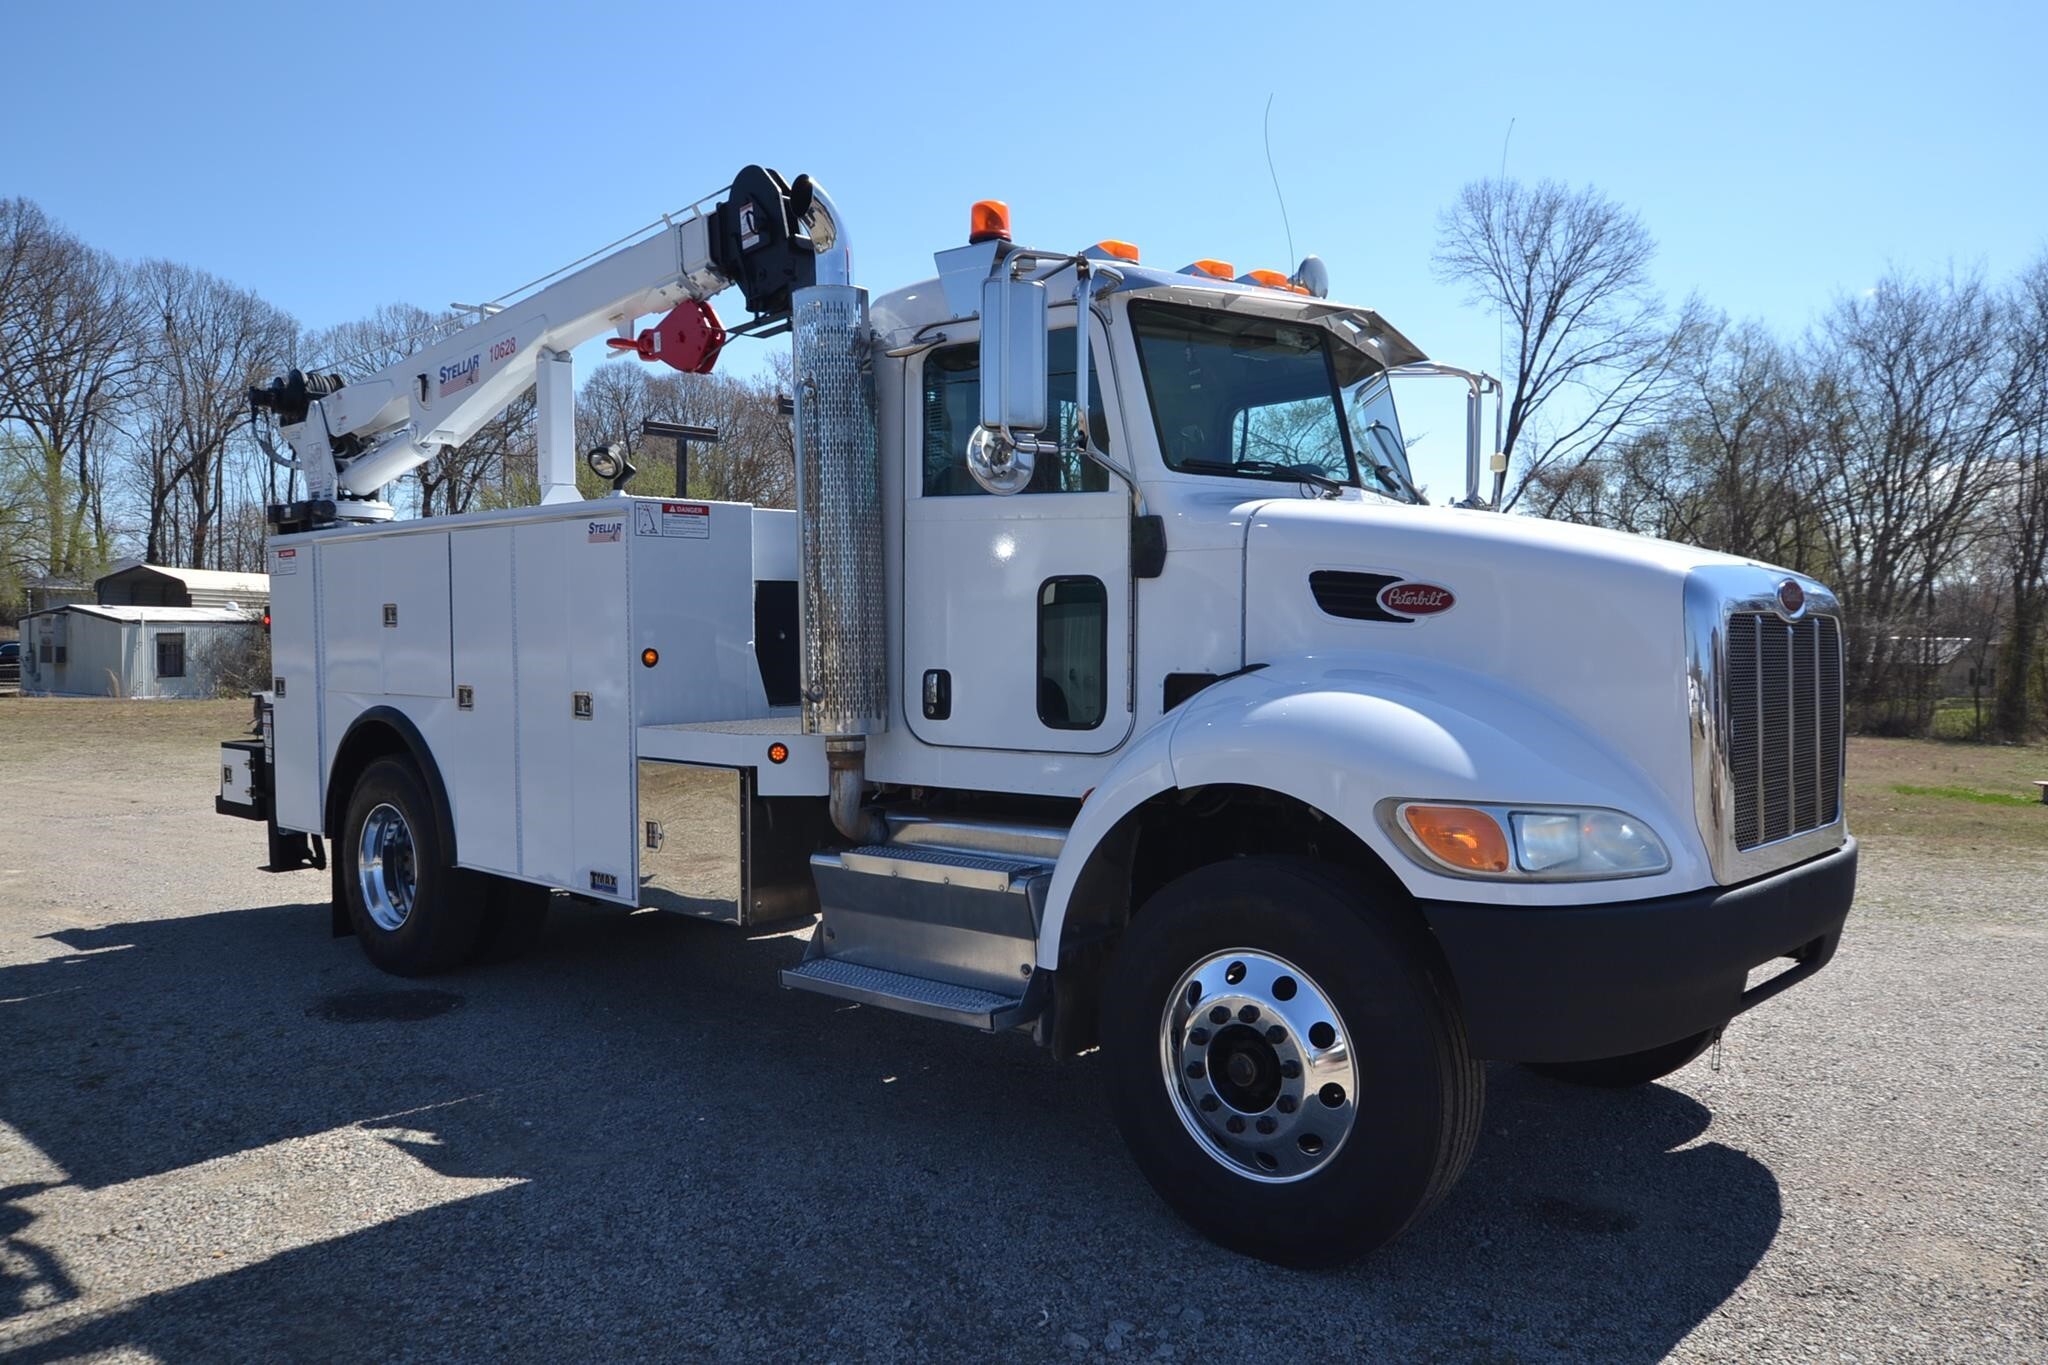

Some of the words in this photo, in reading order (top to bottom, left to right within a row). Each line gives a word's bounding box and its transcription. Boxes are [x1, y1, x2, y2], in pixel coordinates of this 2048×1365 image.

[489, 337, 516, 362] 10628
[439, 354, 480, 384] STELLAR
[676, 505, 704, 514] DANGER
[588, 522, 622, 534] STELLAR
[1388, 588, 1449, 606] Peterbilt
[590, 871, 617, 888] TMAX
